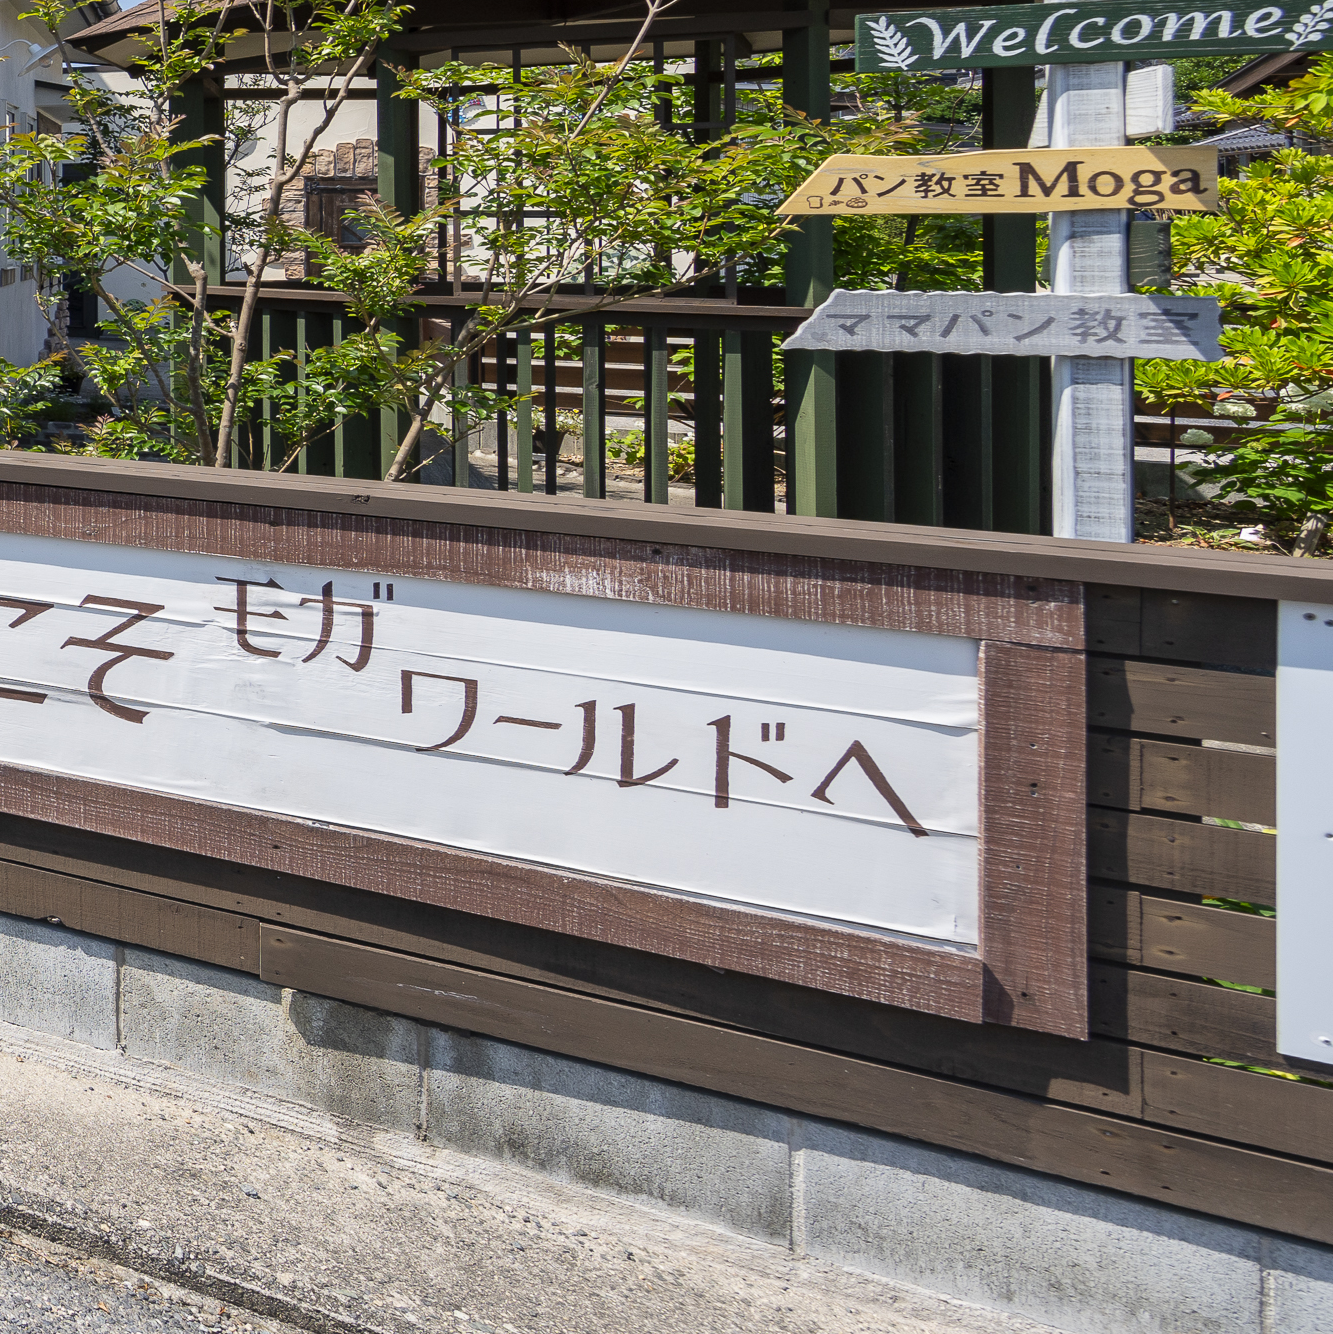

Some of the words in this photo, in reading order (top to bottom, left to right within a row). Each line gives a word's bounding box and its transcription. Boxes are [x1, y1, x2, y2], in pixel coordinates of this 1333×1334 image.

[905, 6, 1284, 60] Welcome
[828, 169, 1006, 200] パン教室
[1012, 160, 1210, 209] Moga
[825, 306, 1202, 347] ママパン教室
